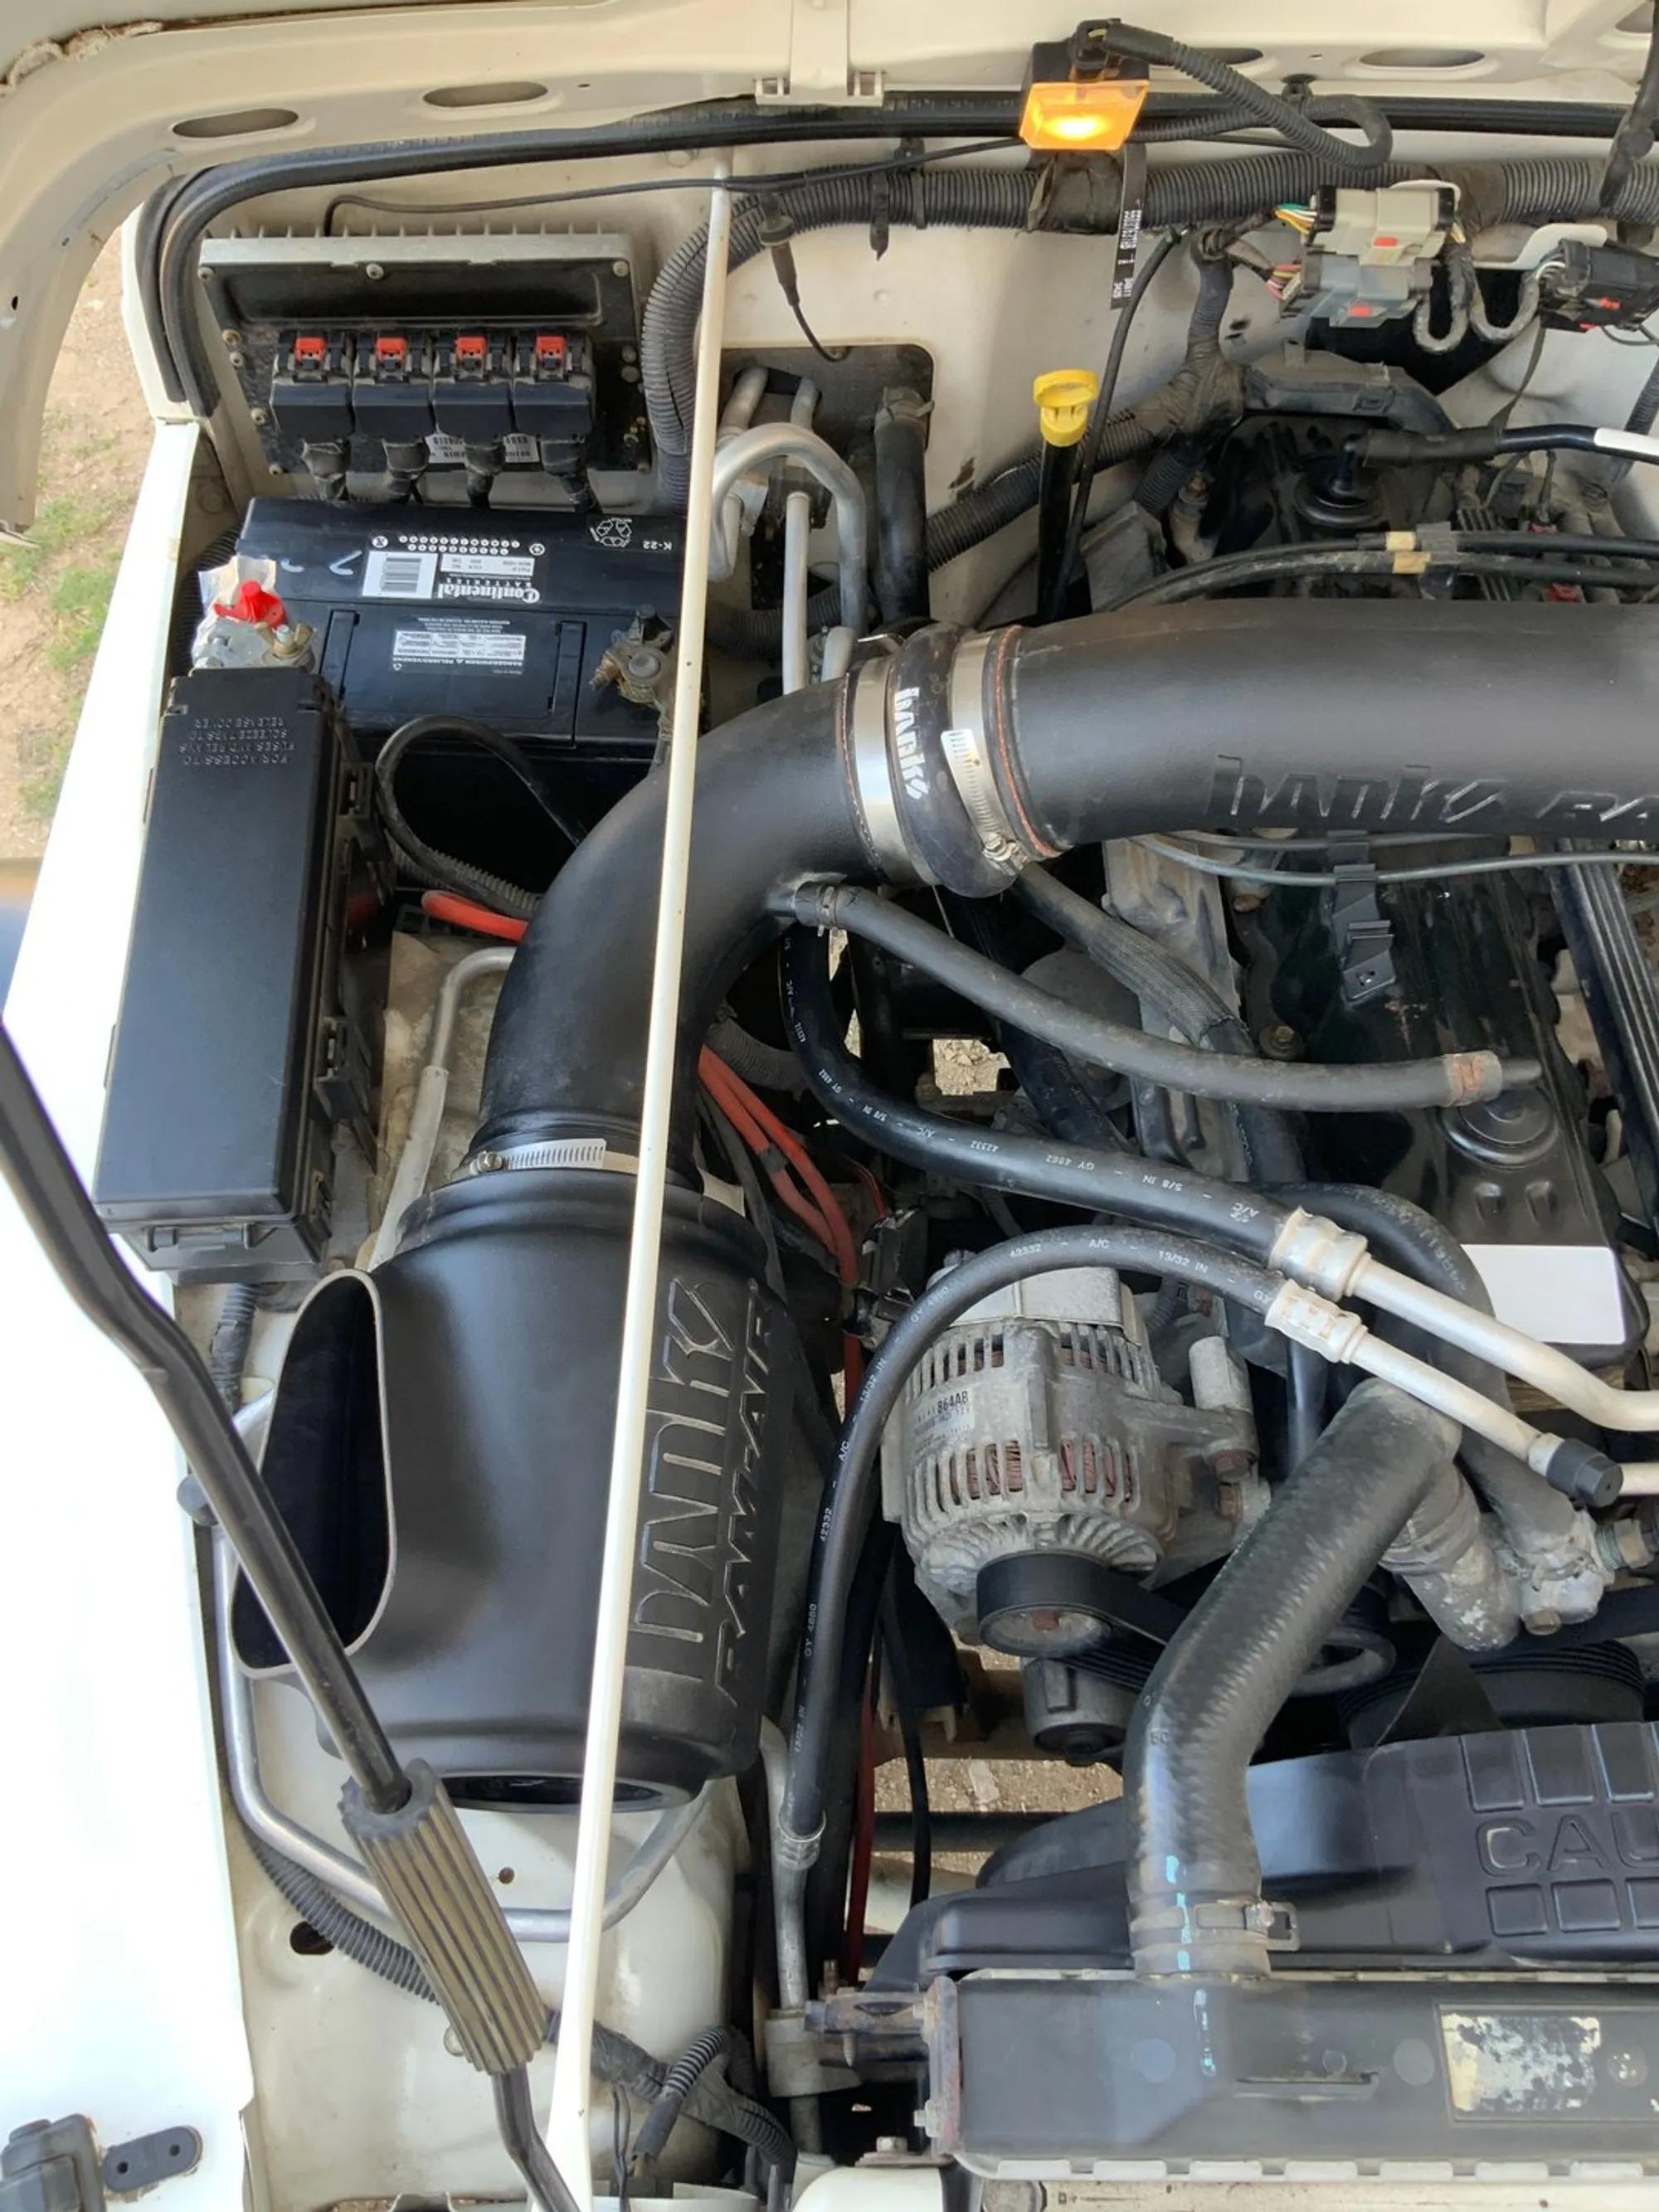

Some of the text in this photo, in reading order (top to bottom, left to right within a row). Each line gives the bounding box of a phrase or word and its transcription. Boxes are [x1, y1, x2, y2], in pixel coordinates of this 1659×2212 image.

[643, 540, 673, 551] K-22
[445, 577, 532, 588] BATTERIES
[437, 584, 539, 604] Continental
[916, 1127, 936, 1140] A/C
[970, 1140, 1000, 1154] 42332
[1162, 1179, 1184, 1192] 5/8
[820, 1508, 833, 1543] 42332
[838, 1441, 850, 1461] A/C
[1010, 1243, 1043, 1258] 42332
[1088, 1239, 1110, 1250] A/C
[1158, 1251, 1190, 1268] 13/32
[1194, 1262, 1209, 1275] IN
